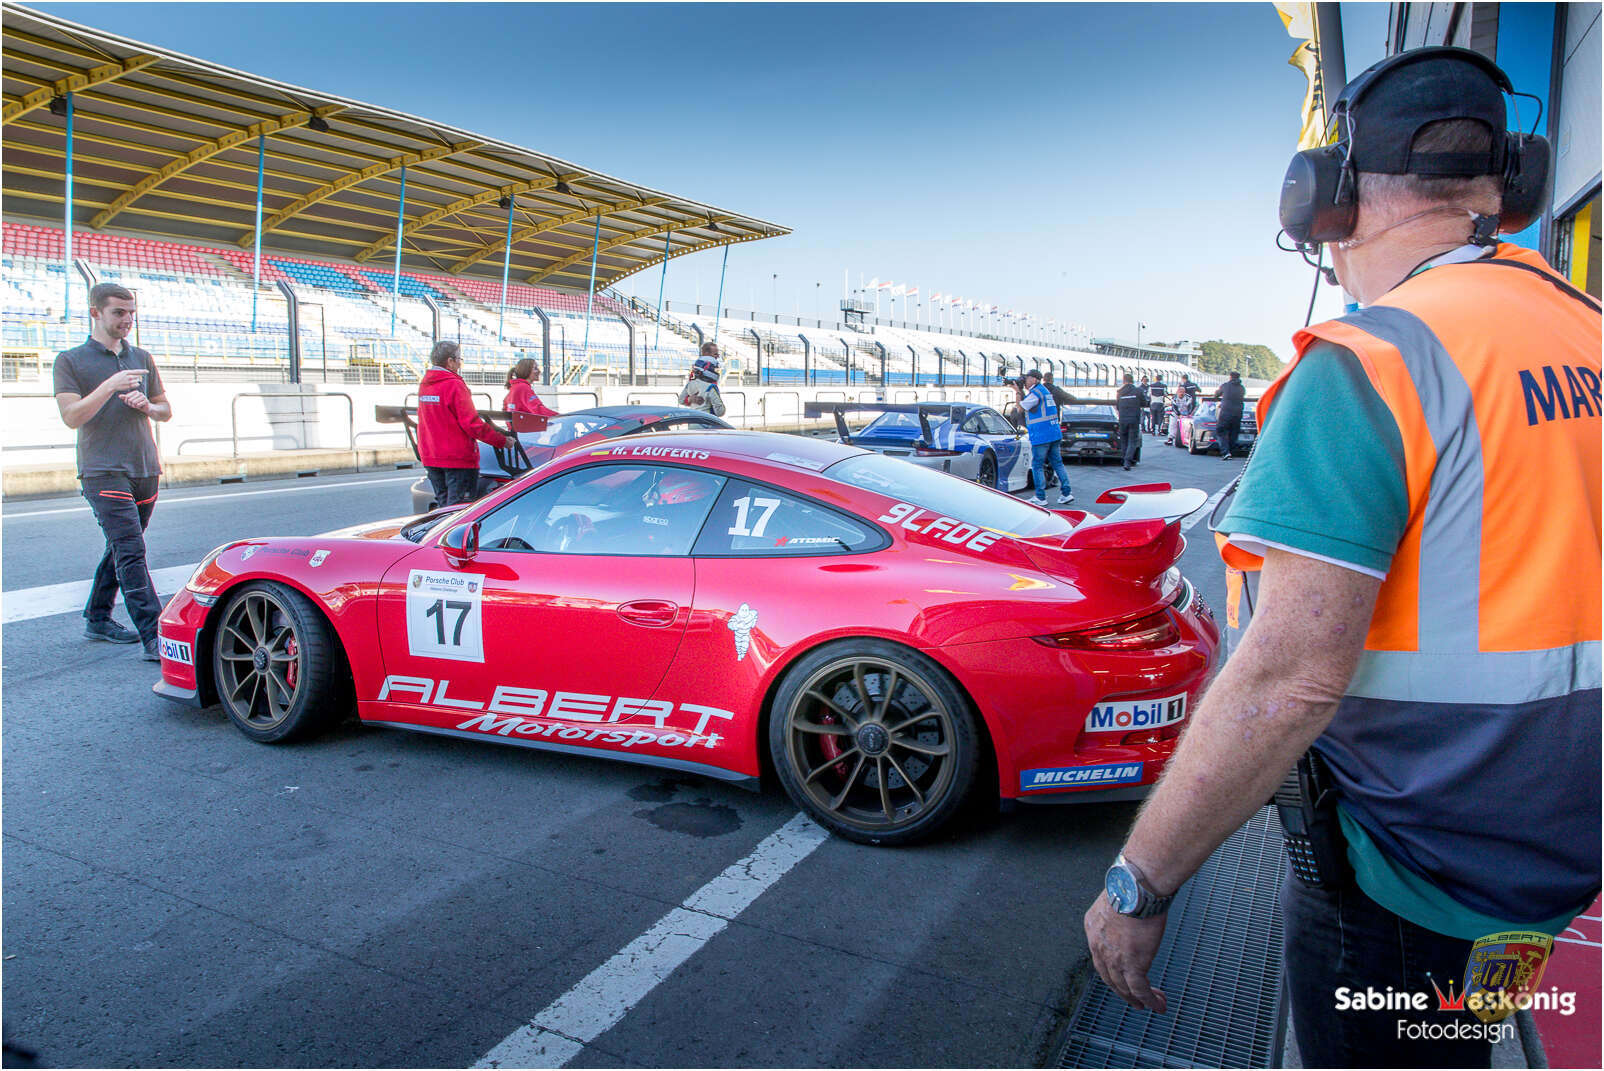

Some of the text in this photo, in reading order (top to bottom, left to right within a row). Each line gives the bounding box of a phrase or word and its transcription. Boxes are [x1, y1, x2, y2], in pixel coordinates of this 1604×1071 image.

[1517, 366, 1602, 426] MAR
[612, 446, 711, 460] H. LAUFERTS
[728, 496, 781, 537] 17
[877, 503, 1004, 552] 9LF.DE
[788, 536, 840, 544] ATOMIC
[425, 576, 465, 586] Porsche Club
[426, 599, 472, 647] 17
[377, 674, 734, 734] ALBERT
[1091, 703, 1162, 727] Mobil
[456, 713, 725, 749] Motorsport
[1033, 765, 1140, 784] MICHELIN
